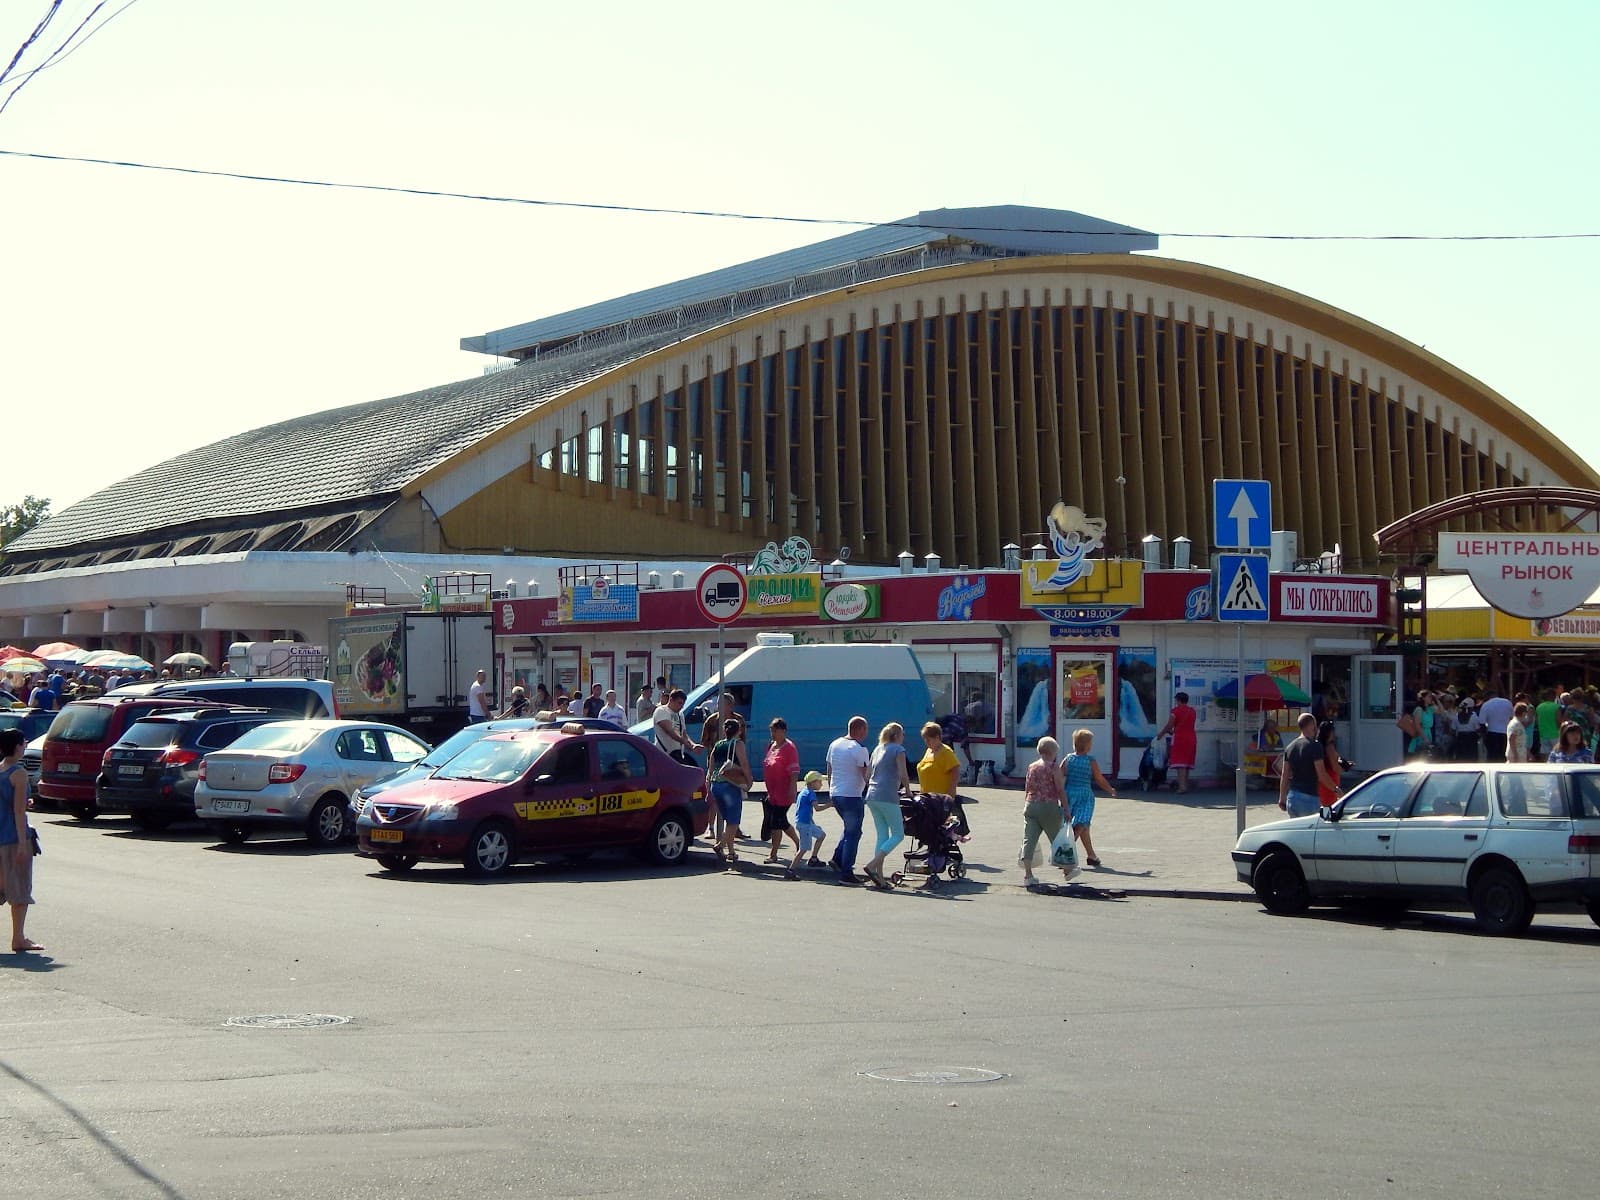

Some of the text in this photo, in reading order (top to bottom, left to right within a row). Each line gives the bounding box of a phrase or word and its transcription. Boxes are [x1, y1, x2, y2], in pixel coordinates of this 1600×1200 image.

[1502, 565, 1573, 580] РЫНОК
[1286, 587, 1372, 613] МЫ ОТКРЫЛИСЬ
[601, 795, 623, 811] 181
